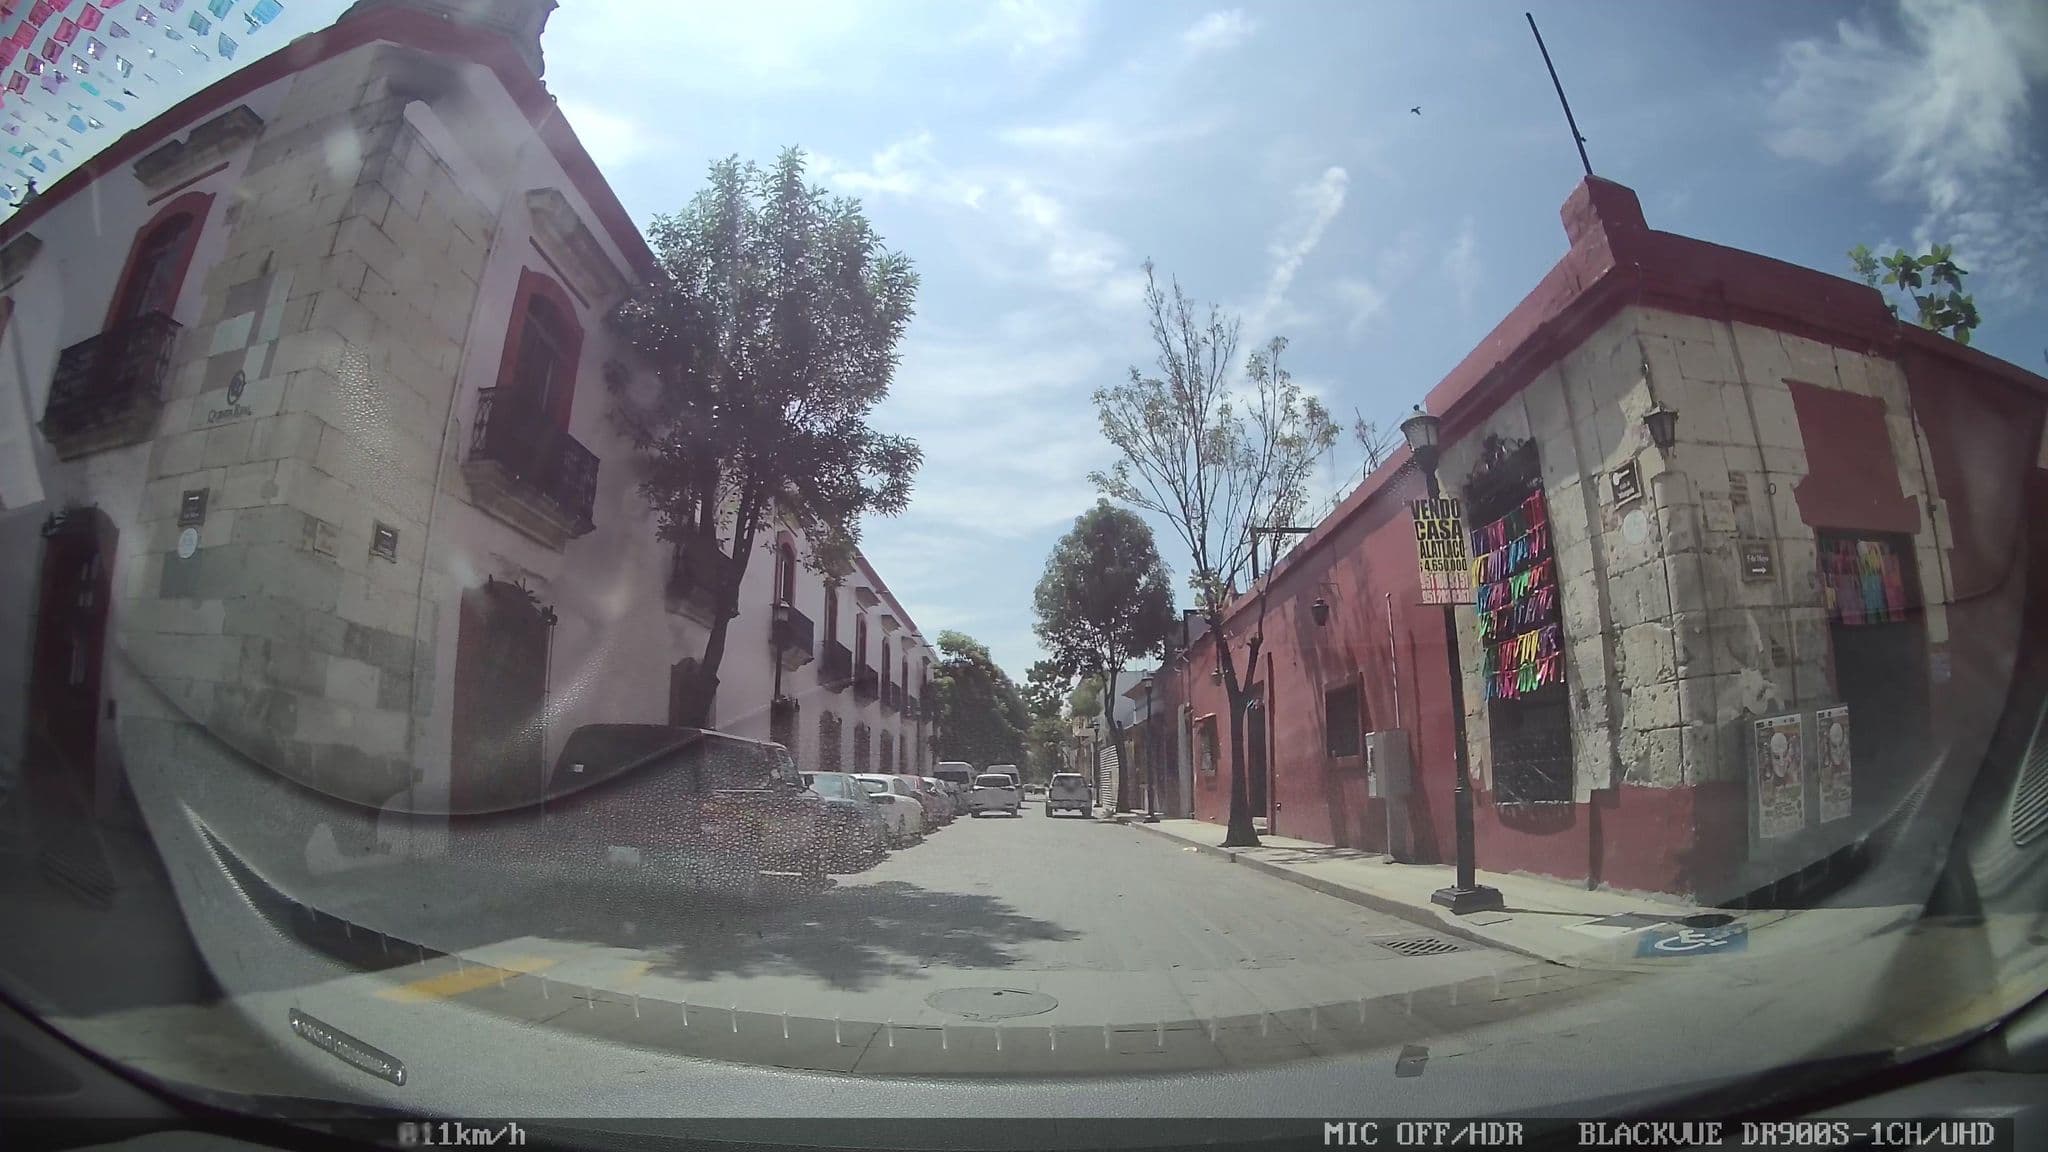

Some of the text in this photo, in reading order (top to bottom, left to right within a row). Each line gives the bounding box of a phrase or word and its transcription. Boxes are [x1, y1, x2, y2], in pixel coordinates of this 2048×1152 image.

[1411, 498, 1461, 520] VENDO
[1414, 520, 1464, 541] CASA
[1419, 540, 1466, 559] ALATLACO
